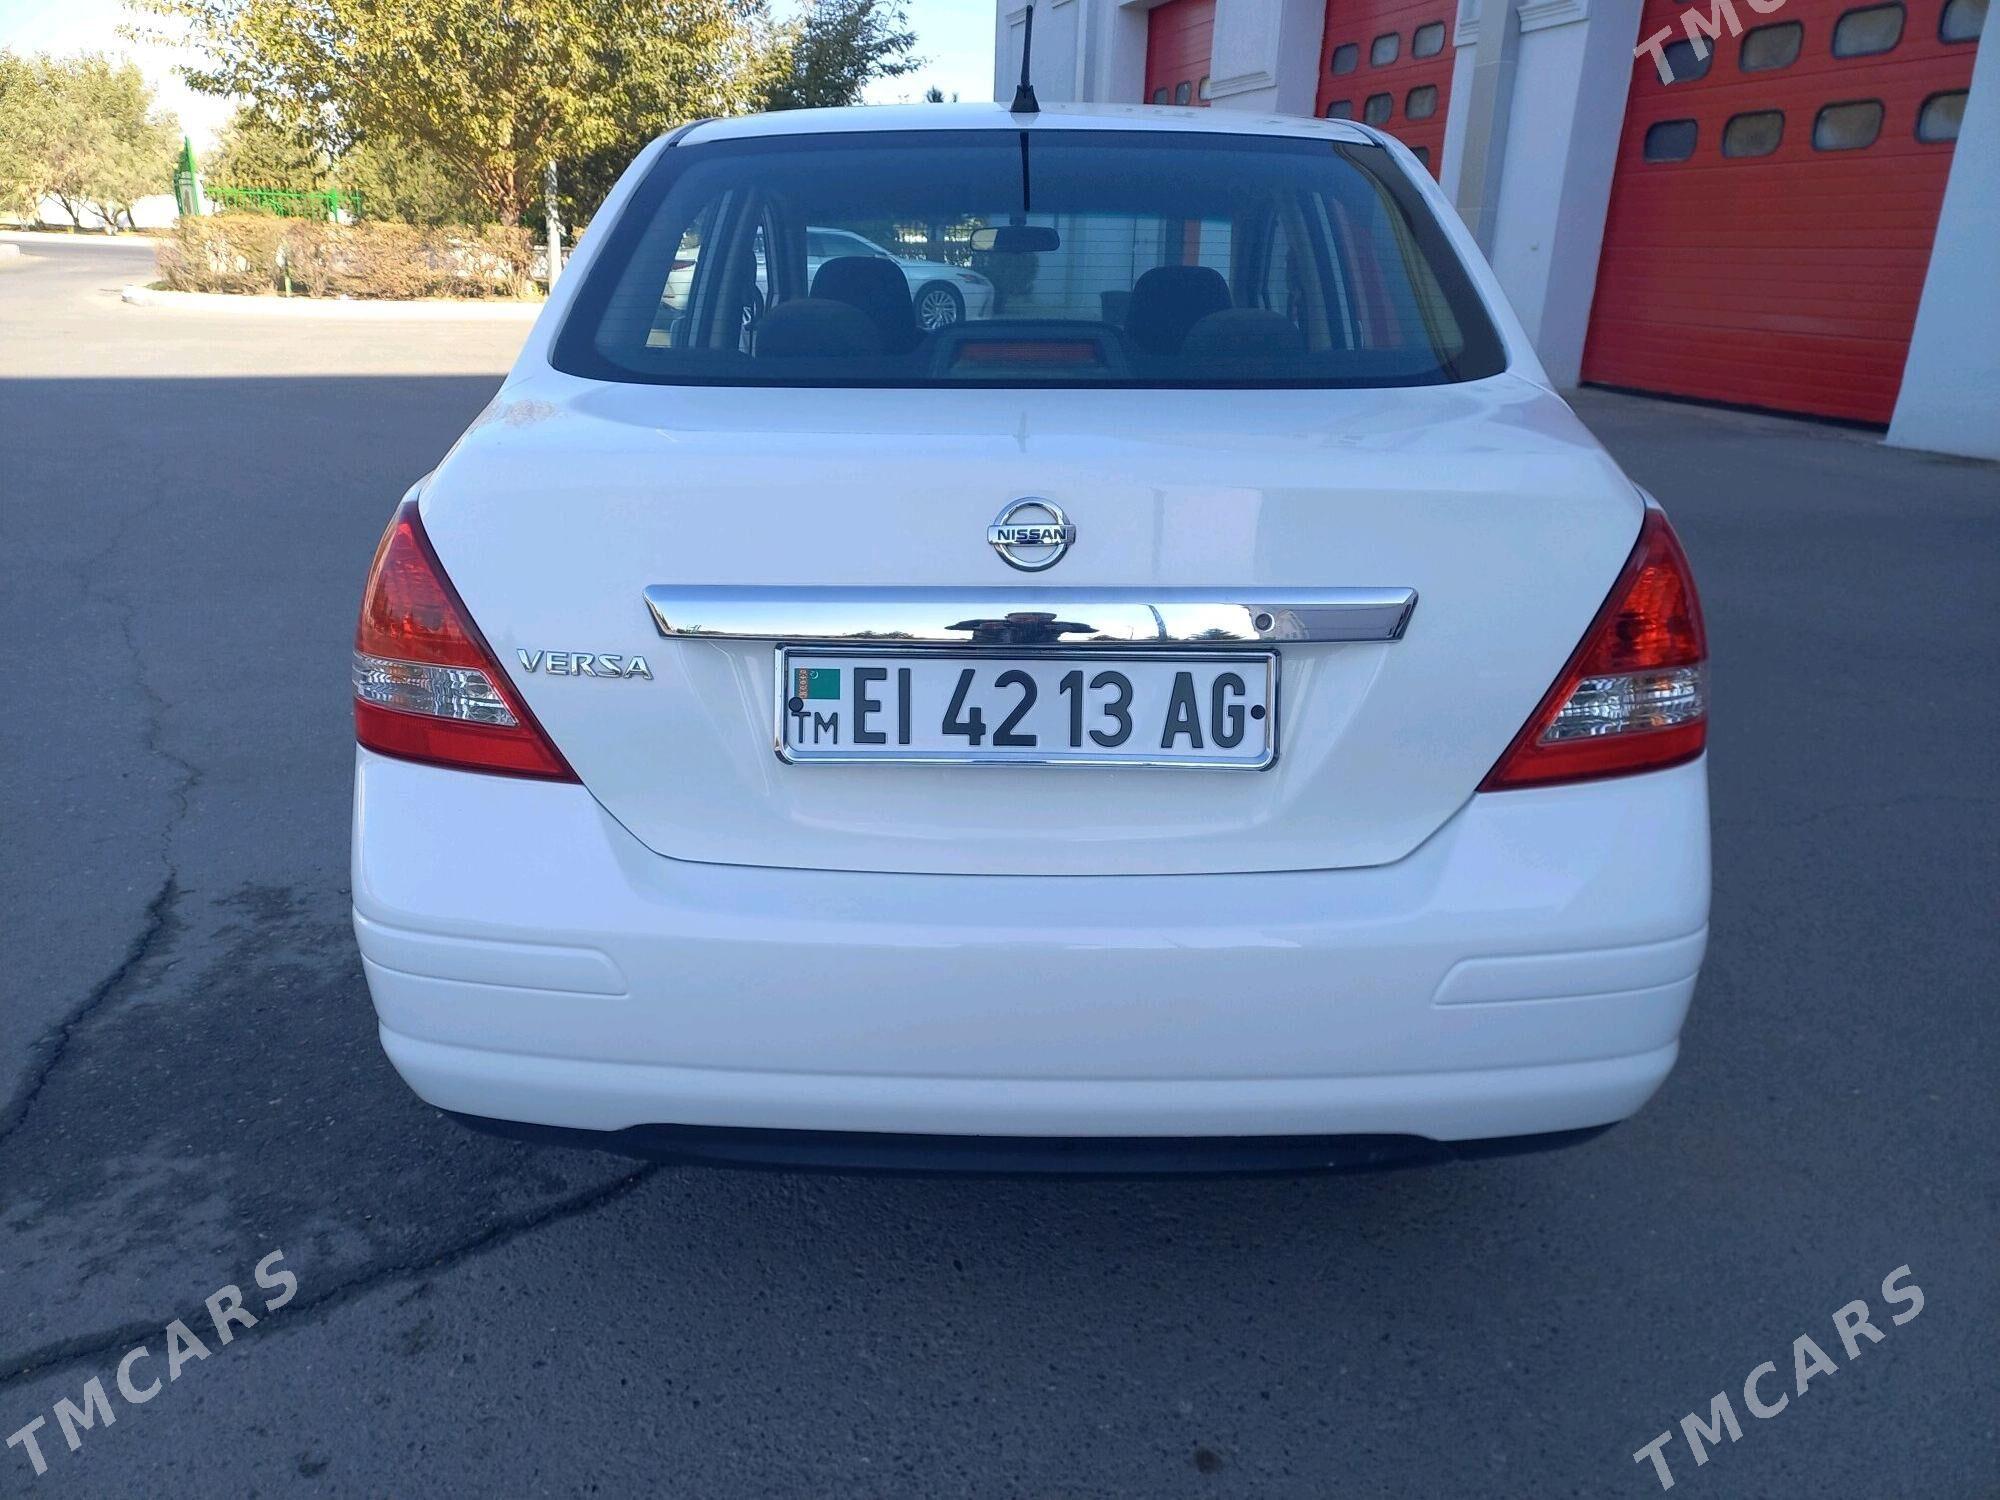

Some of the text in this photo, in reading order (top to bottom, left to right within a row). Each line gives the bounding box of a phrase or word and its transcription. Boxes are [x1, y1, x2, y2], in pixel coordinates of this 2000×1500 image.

[997, 528, 1067, 541] NISSAN
[516, 648, 654, 680] VERSA
[853, 667, 911, 745] EI
[1160, 671, 1246, 749] AG
[791, 710, 839, 745] TM
